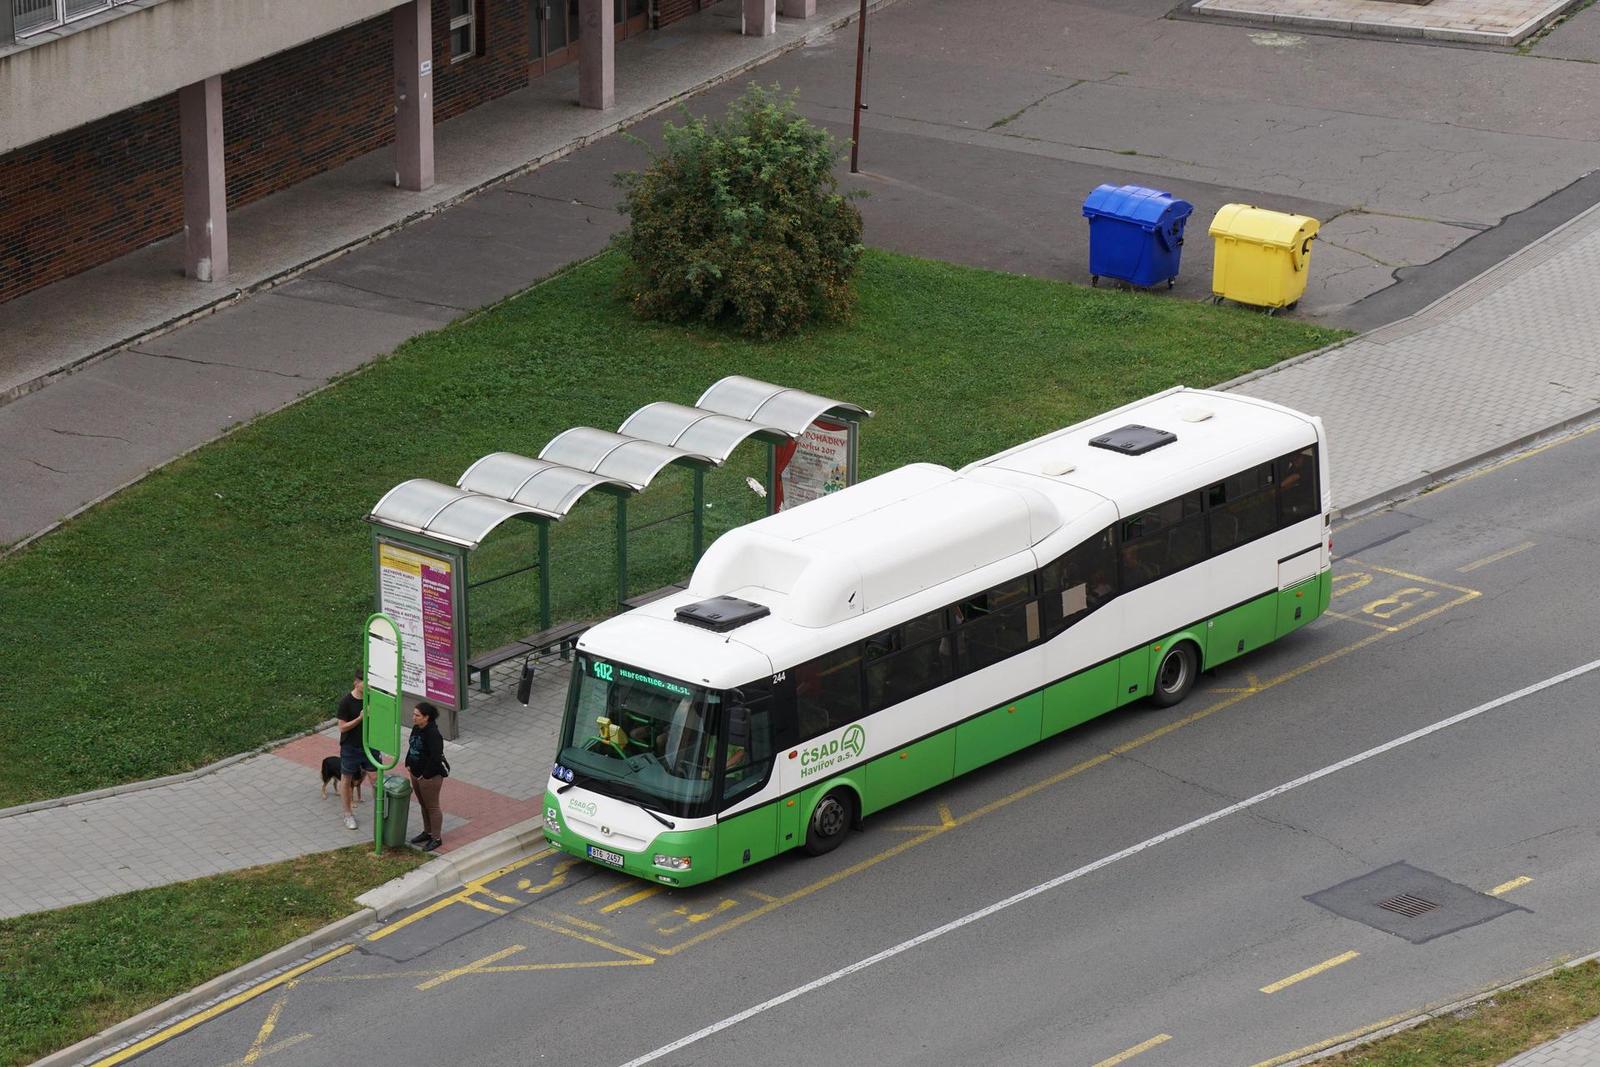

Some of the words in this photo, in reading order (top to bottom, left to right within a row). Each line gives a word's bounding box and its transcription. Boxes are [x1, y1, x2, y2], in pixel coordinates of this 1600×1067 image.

[594, 661, 613, 681] 402
[772, 672, 786, 684] 244
[800, 740, 839, 766] ČSAD
[800, 757, 835, 778] Havířov
[837, 751, 853, 763] a.s.
[607, 853, 621, 863] 2457
